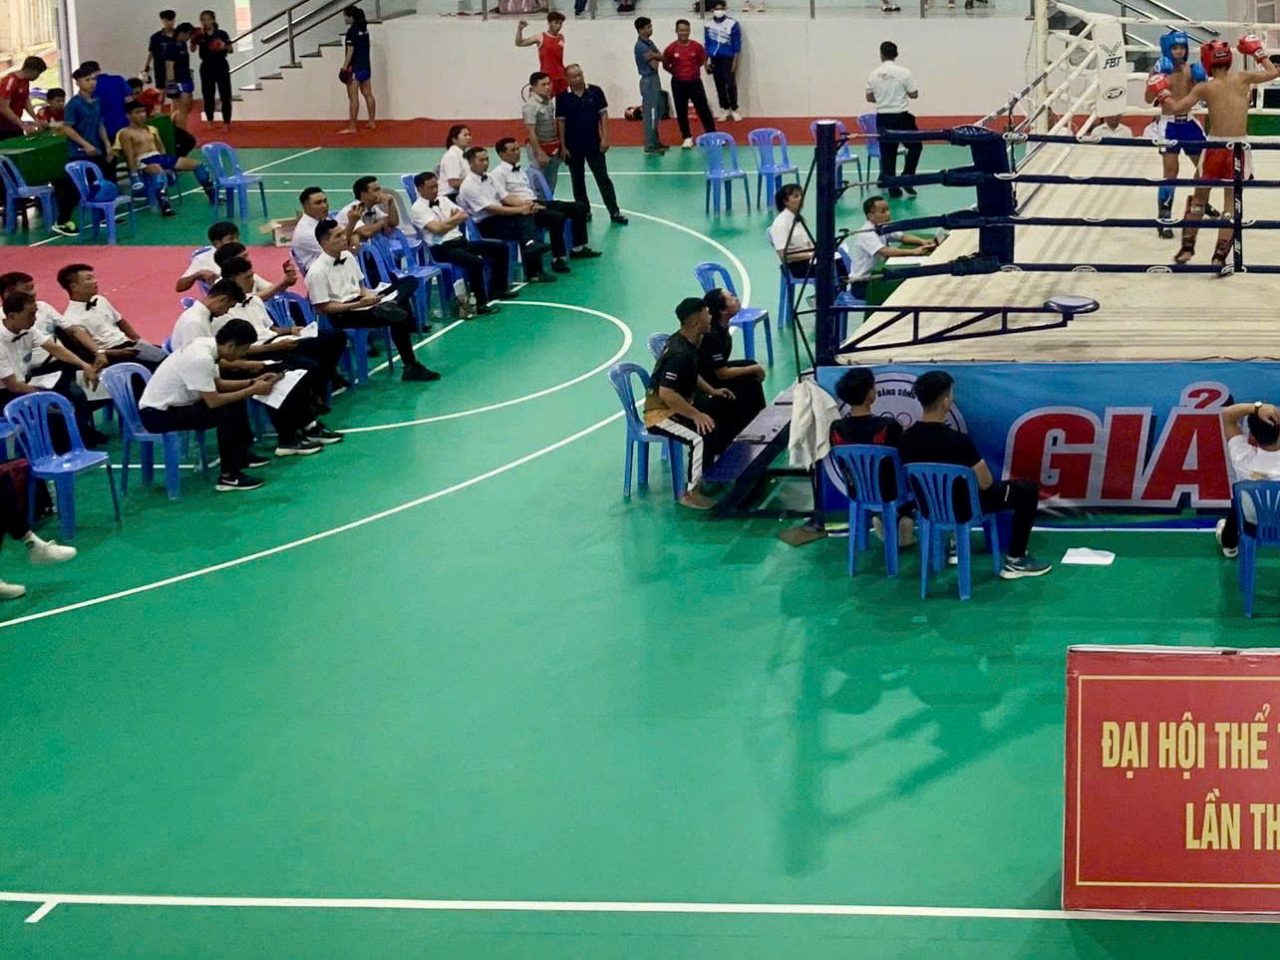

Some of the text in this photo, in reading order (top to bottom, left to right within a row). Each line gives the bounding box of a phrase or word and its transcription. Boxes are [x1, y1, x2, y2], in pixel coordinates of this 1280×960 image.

[1102, 56, 1123, 69] FBT
[1101, 721, 1149, 779] ĐẠI
[1158, 711, 1206, 780] HỘI
[1214, 703, 1269, 770] THỂ
[1185, 788, 1241, 850] LẦN
